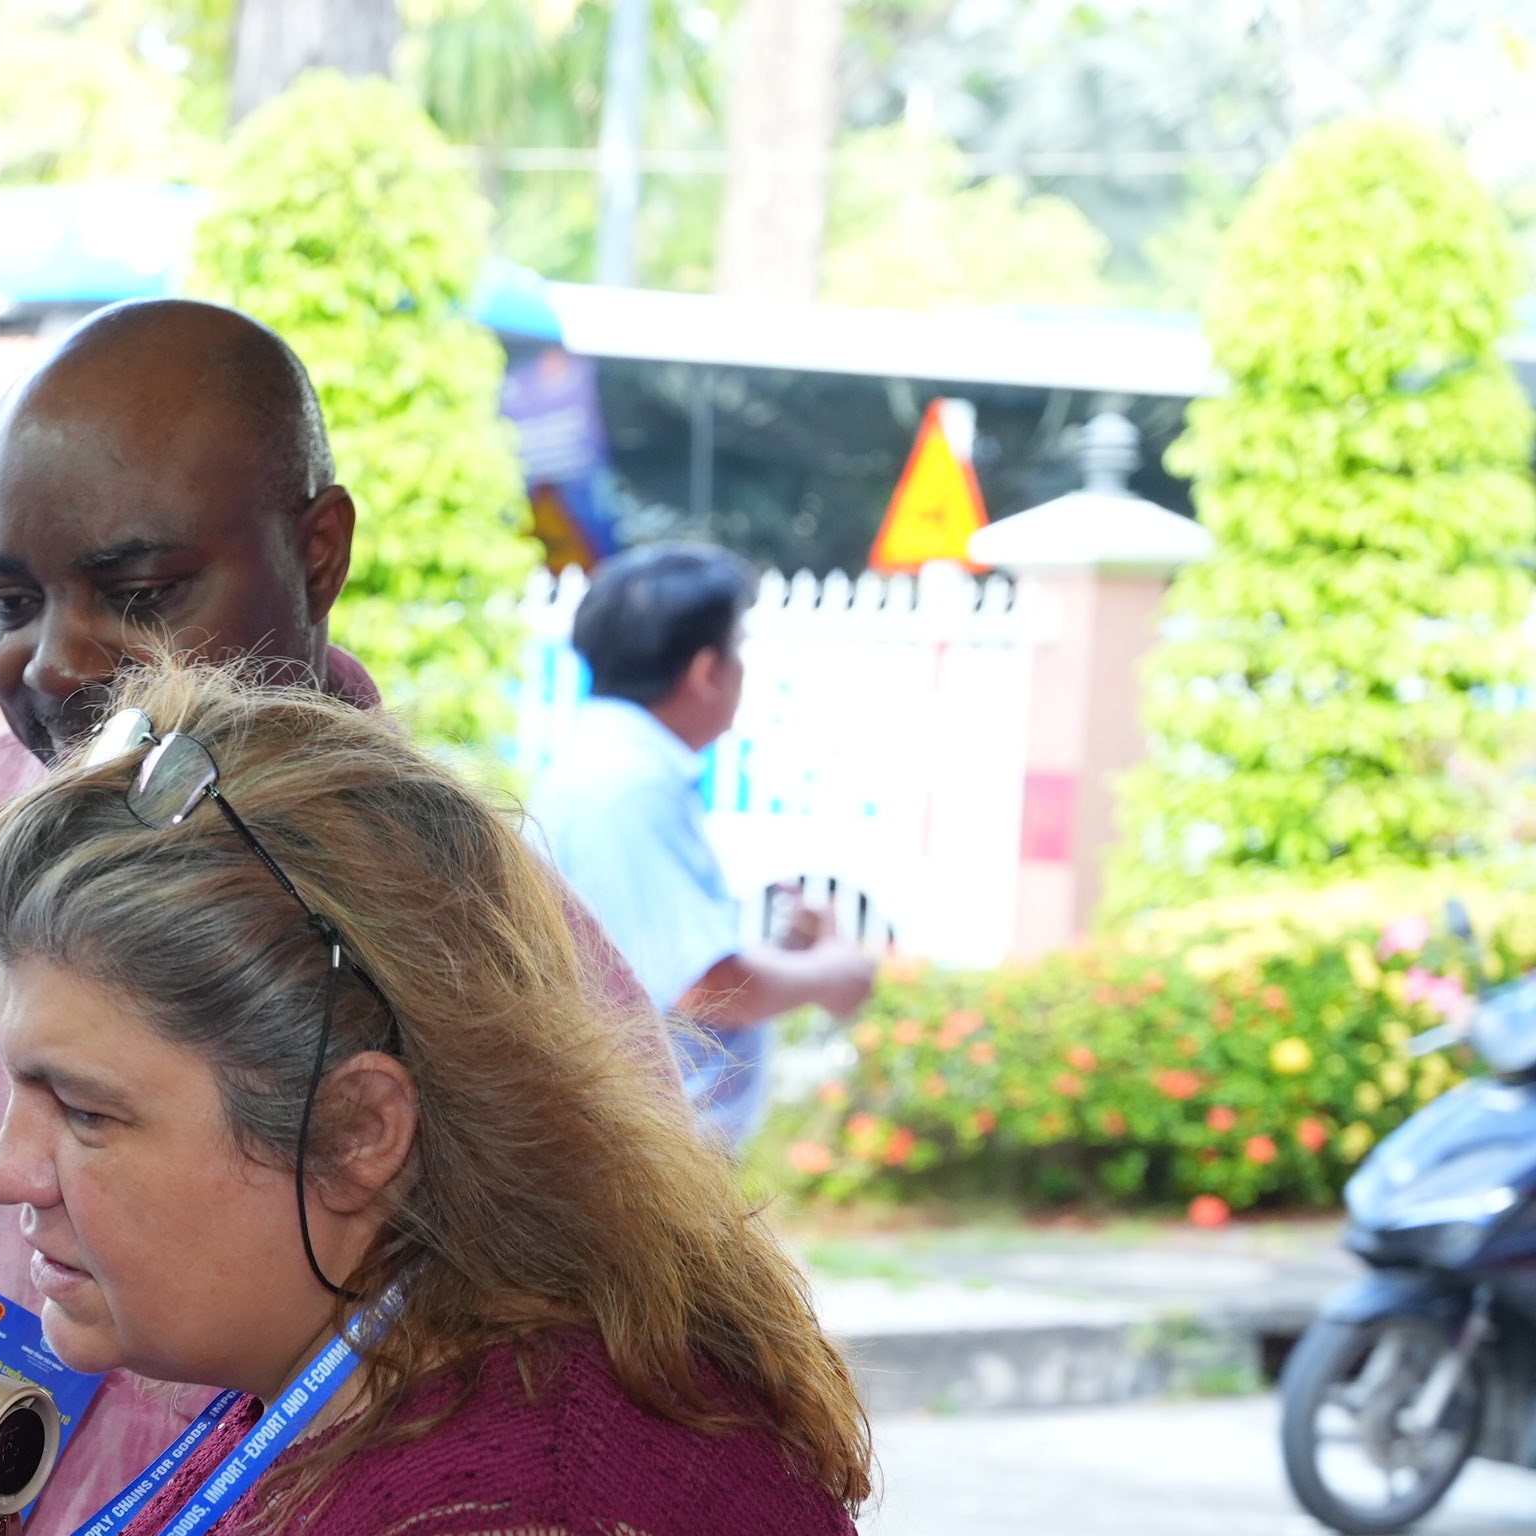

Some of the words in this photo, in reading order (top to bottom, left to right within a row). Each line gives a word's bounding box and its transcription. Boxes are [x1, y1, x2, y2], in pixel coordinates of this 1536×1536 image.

[280, 1387, 310, 1418] AND
[111, 1479, 154, 1518] CHAINS
[150, 1458, 175, 1482] FOR
[210, 1390, 237, 1418] IMPO
